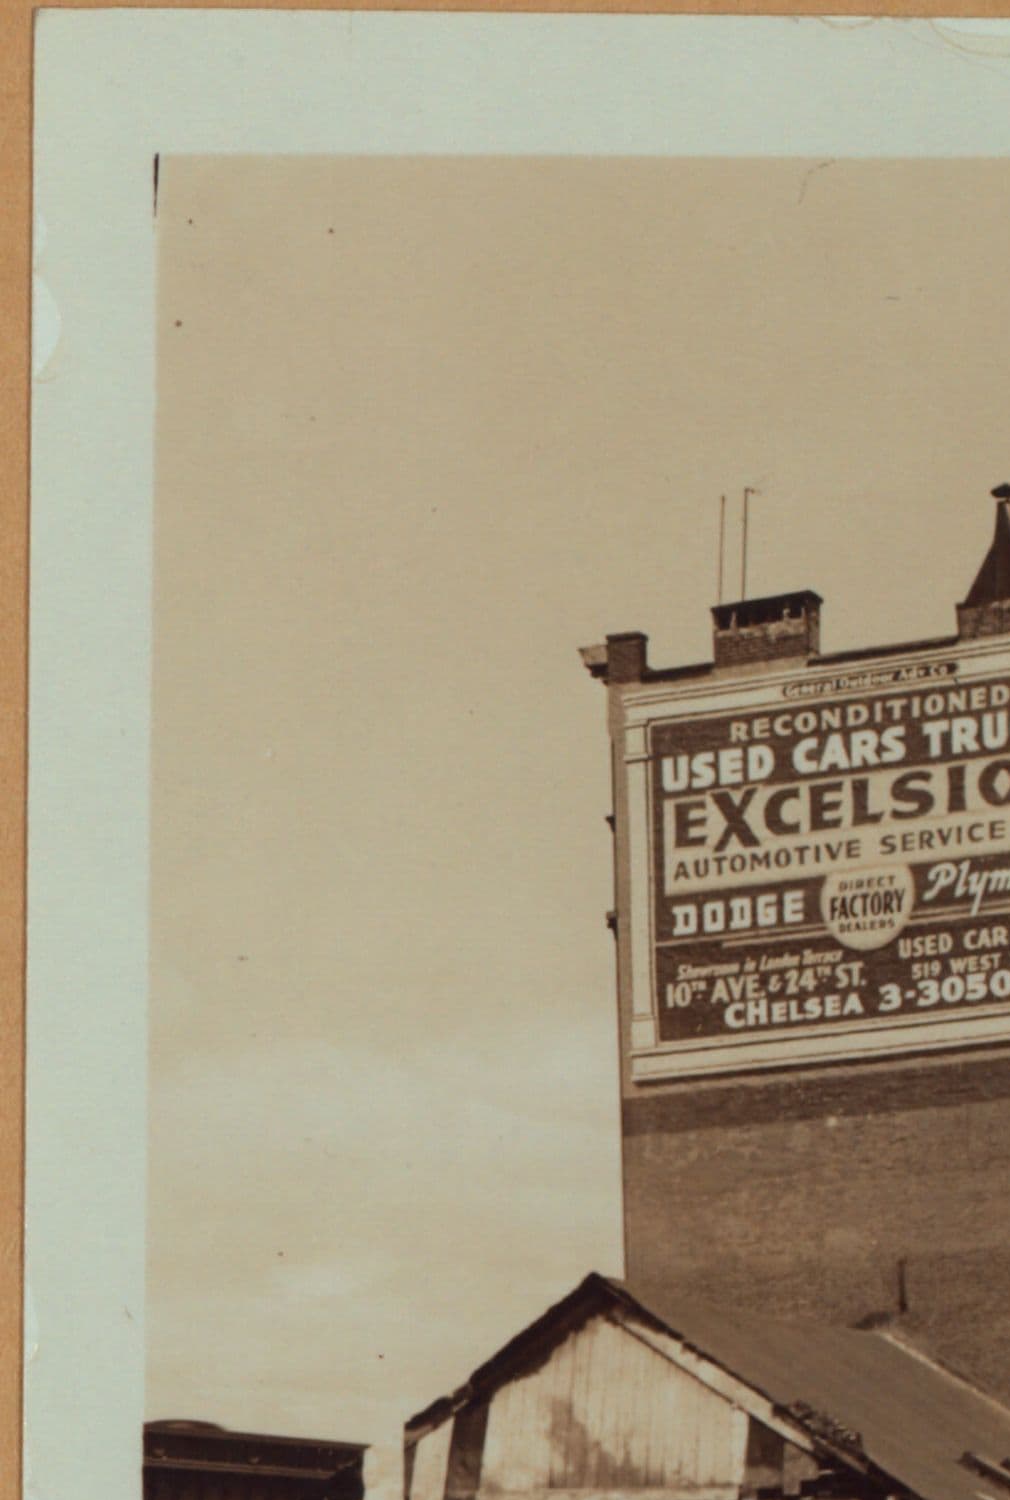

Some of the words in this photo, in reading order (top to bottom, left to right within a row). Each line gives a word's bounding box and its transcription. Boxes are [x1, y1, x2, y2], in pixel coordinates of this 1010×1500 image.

[730, 684, 1010, 742] RECONDITIONED
[661, 744, 775, 792] USED
[792, 726, 906, 774] CARS
[674, 845, 861, 882] AUTOMOTIVE
[880, 820, 1006, 855] SERVICE
[838, 874, 896, 892] DIRECT
[672, 889, 805, 937] DODGE
[830, 888, 905, 922] FACTORY
[898, 931, 953, 960] USED
[963, 924, 1009, 951] CAR
[834, 960, 867, 988] ST.
[911, 960, 942, 981] 519
[950, 952, 1002, 975] WEST
[724, 991, 865, 1028] CHELSEA
